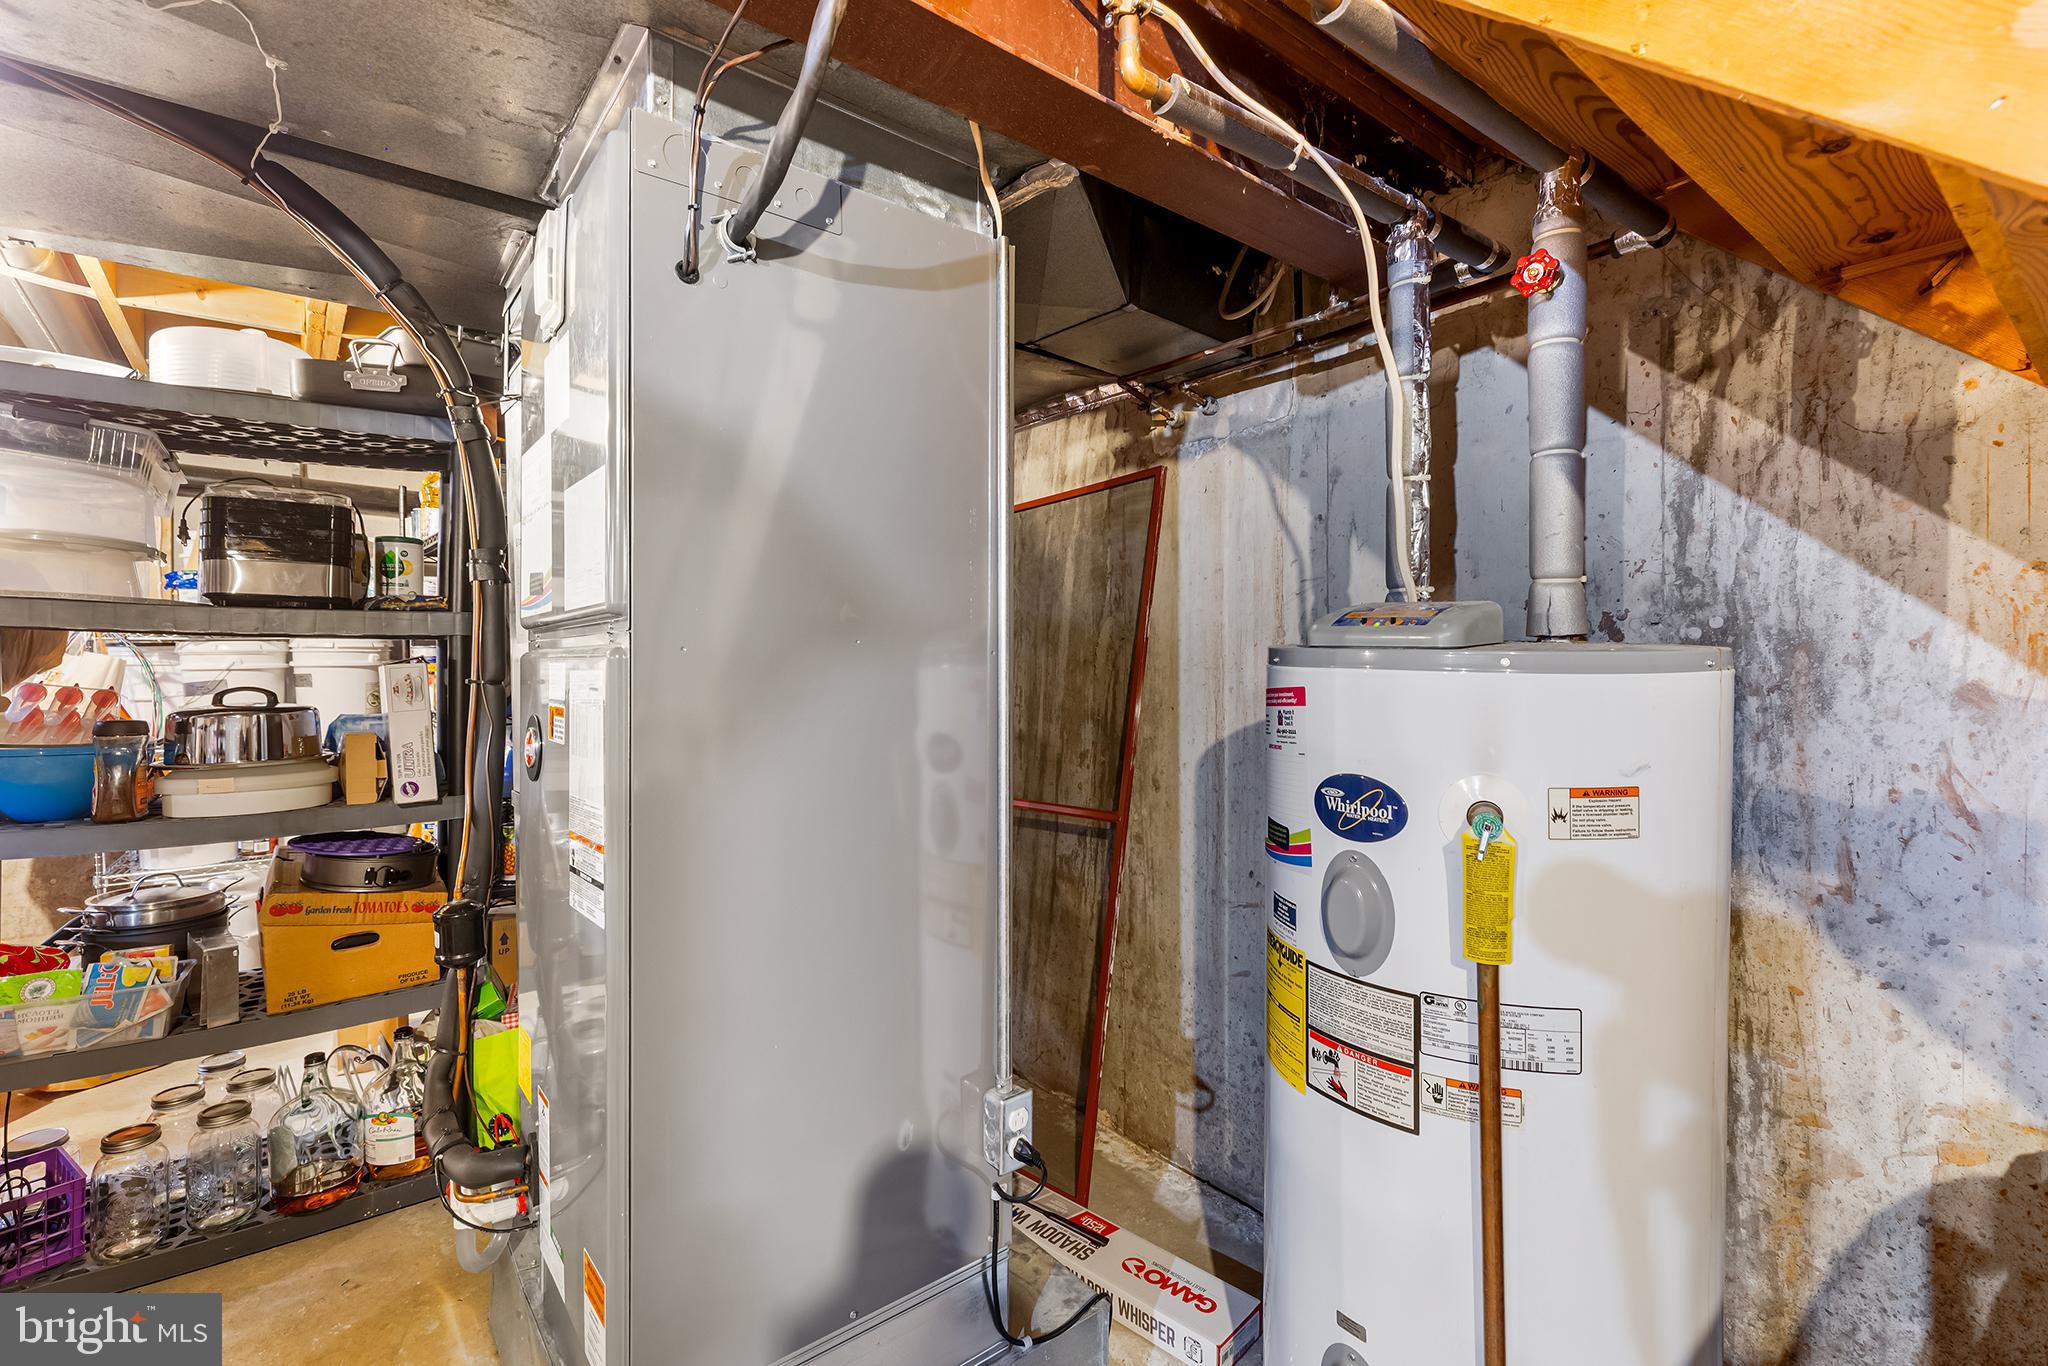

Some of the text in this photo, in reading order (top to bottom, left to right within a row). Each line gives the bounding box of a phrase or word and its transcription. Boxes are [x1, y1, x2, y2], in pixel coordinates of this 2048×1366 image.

[404, 741, 415, 779] ULTRA
[1325, 795, 1393, 820] Whirlpool
[304, 900, 409, 916] Garden Fresh TOMATOES
[398, 969, 429, 979] PRODUCE
[1344, 1048, 1378, 1066] DANGER
[1082, 1217, 1106, 1234] 1250
[1026, 1220, 1095, 1261] SHADOW
[1143, 1269, 1217, 1313] GAMO
[1118, 1297, 1176, 1348] WHISPER
